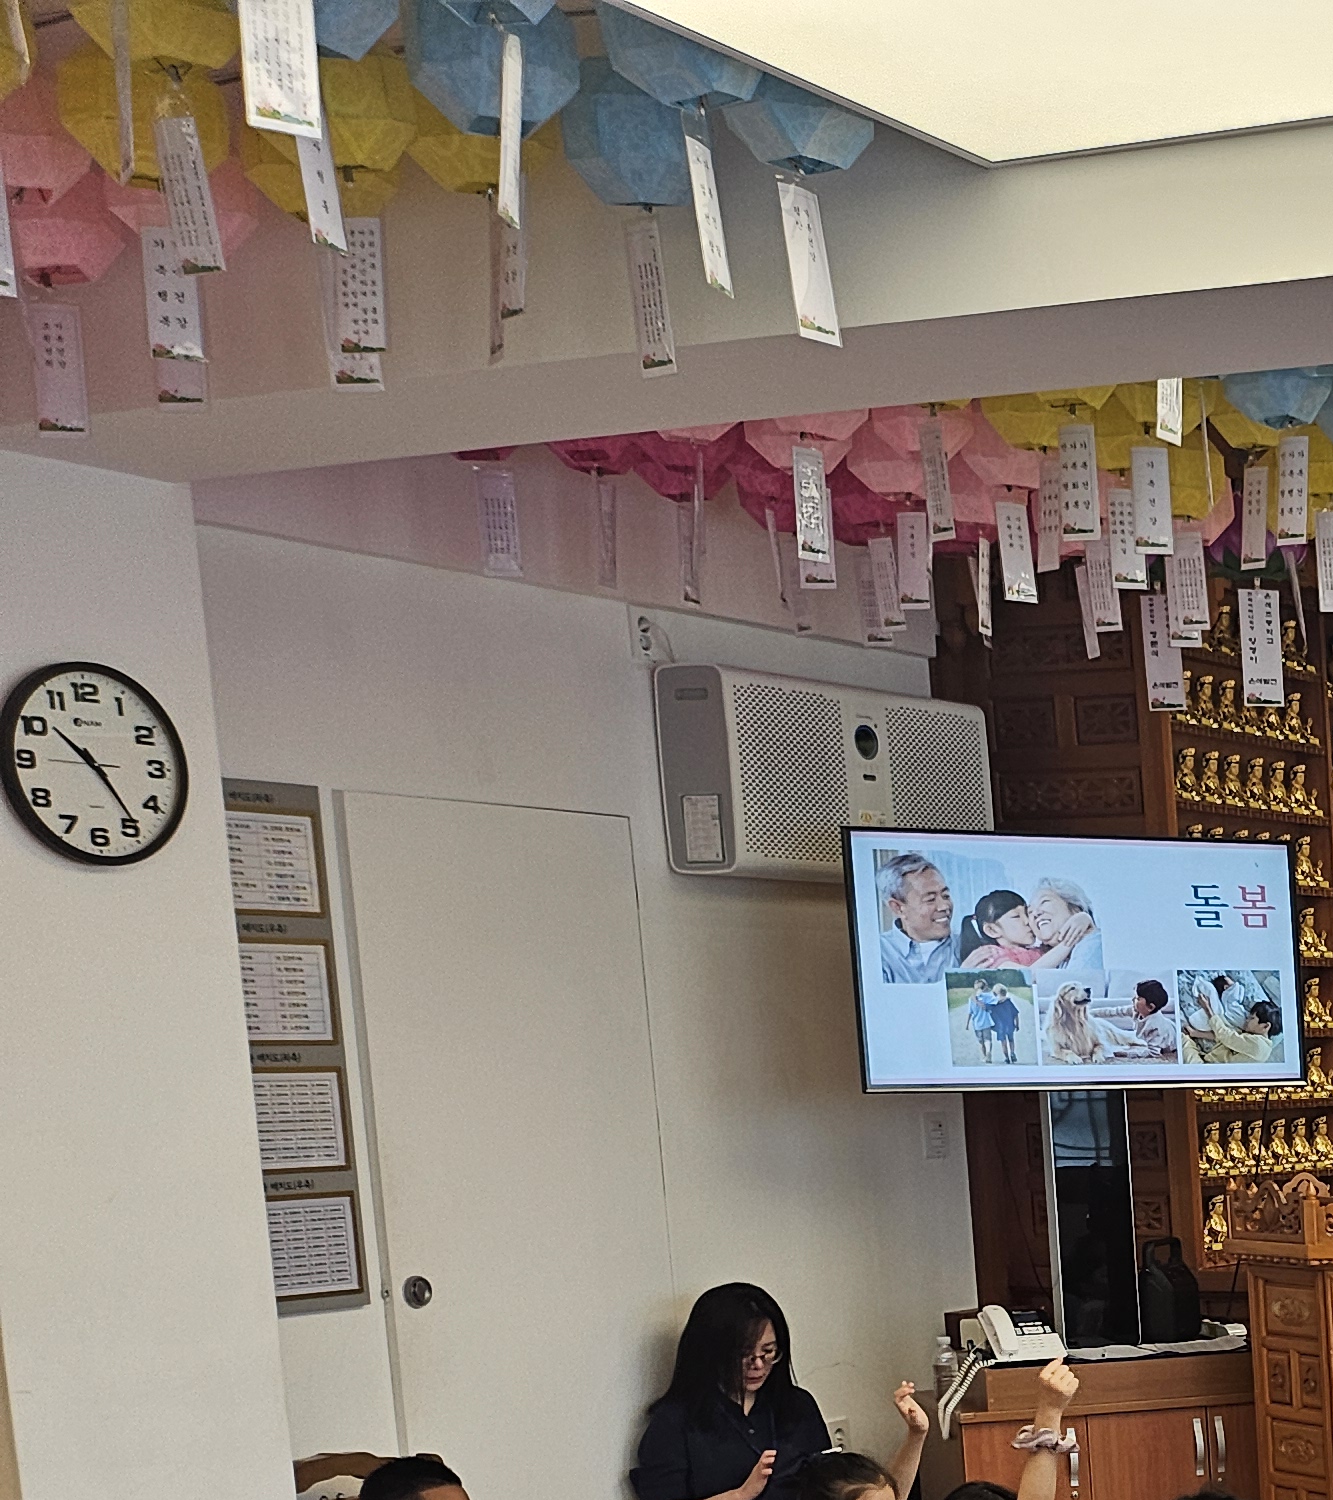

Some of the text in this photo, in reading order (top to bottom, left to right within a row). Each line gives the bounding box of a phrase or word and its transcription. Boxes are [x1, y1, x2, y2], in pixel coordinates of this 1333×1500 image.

[46, 690, 66, 711] 11
[70, 682, 100, 704] 12
[114, 697, 125, 717] 1
[20, 715, 48, 736] 10
[134, 725, 156, 746] 2
[16, 749, 37, 769] 9
[146, 759, 167, 779] 3
[31, 787, 52, 808] 8
[142, 795, 160, 814] 4
[58, 814, 79, 834] 7
[120, 817, 141, 838] 5
[90, 827, 111, 847] 6
[1184, 884, 1277, 929] 돌봄
